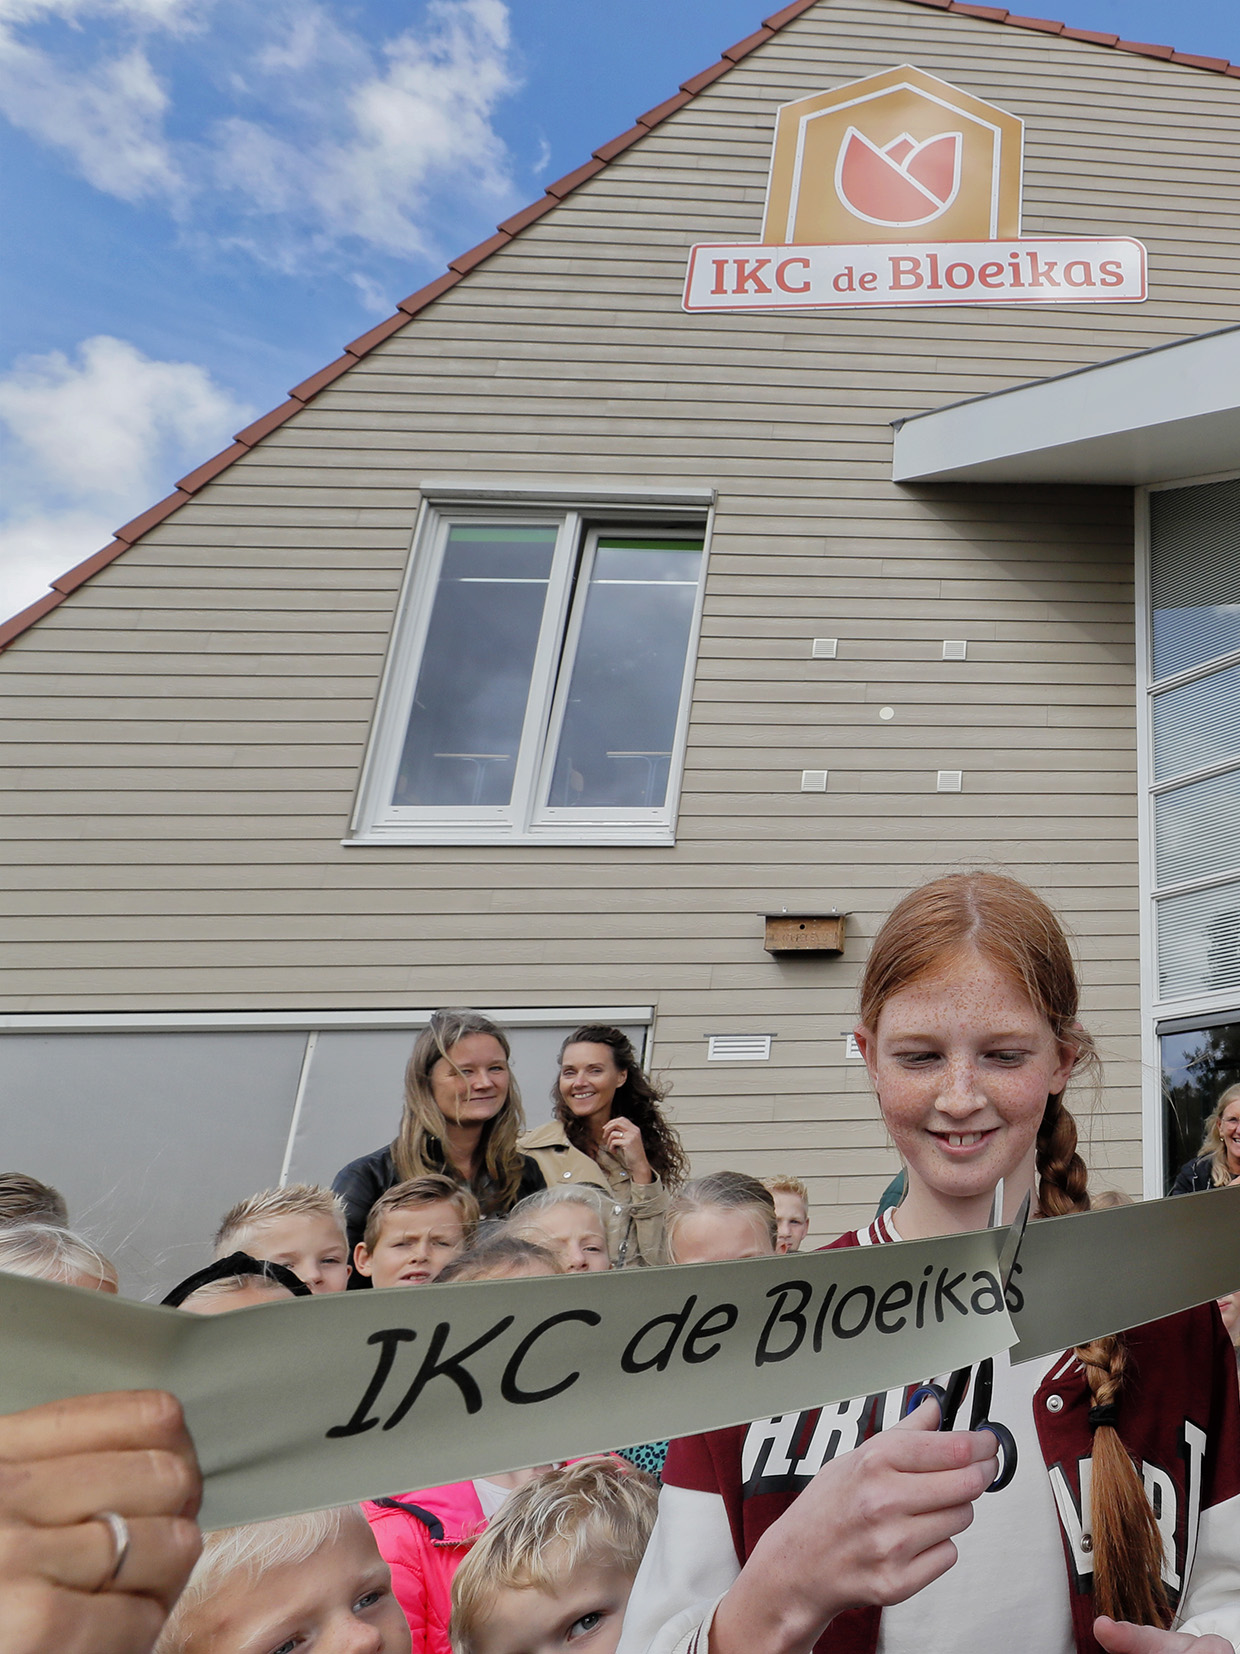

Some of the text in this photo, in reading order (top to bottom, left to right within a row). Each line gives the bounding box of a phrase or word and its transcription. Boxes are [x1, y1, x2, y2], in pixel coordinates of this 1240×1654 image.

[710, 251, 1124, 295] IKC de Bloeikas
[326, 1264, 1025, 1439] IKC de Bloeikas
